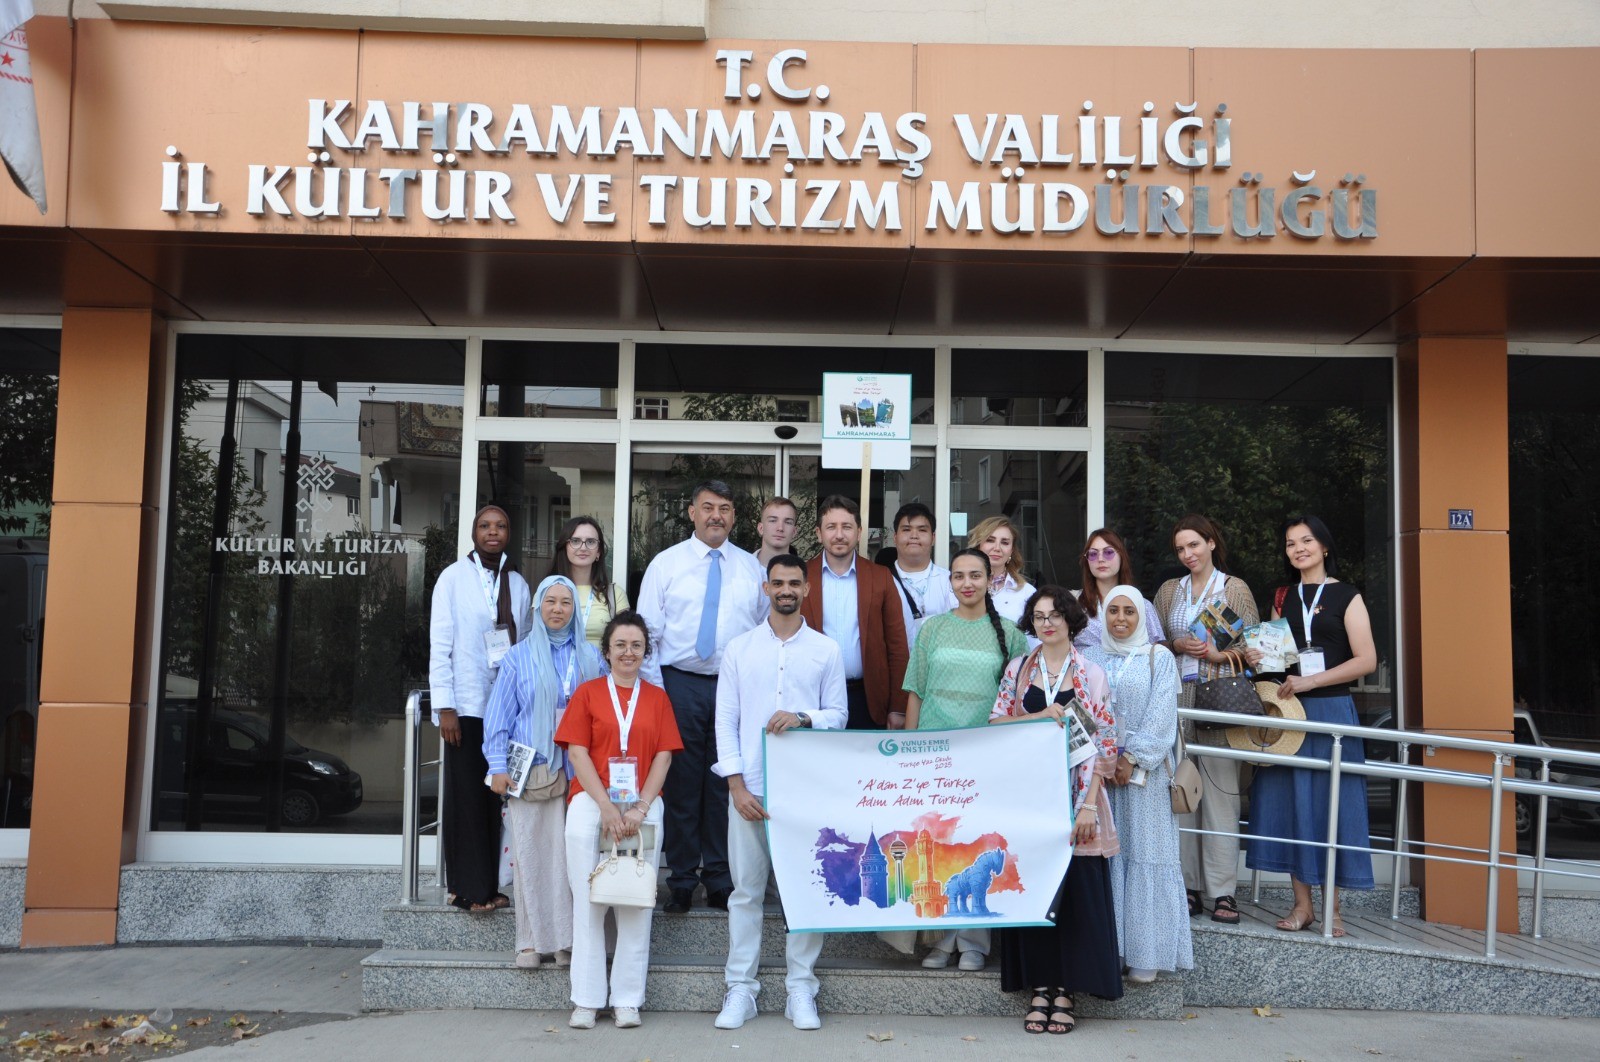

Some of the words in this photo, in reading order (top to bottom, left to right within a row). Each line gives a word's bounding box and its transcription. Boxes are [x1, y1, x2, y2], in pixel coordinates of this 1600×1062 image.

[715, 48, 830, 102] T.C.
[307, 98, 932, 179] KAHRAMANMARAŞ
[953, 100, 1233, 170] VALİLİĞİ
[160, 145, 221, 215] İL
[247, 152, 516, 223] KÜLTÜR
[536, 173, 617, 226] VE
[640, 163, 902, 232] TURİZM
[924, 168, 1378, 239] MÜDÜRLÜĞÜ
[836, 430, 896, 438] KAHRAMANMARAŞ
[296, 518, 331, 533] T.C.
[1451, 514, 1472, 527] 12A
[215, 534, 295, 553] KÜLTÜR
[302, 538, 326, 553] VE
[332, 536, 409, 554] TURİZM
[258, 557, 367, 576] BAKANLIĞI
[934, 777, 976, 791] Türkçe
[856, 795, 887, 808] Adım
[893, 794, 925, 807] Adım
